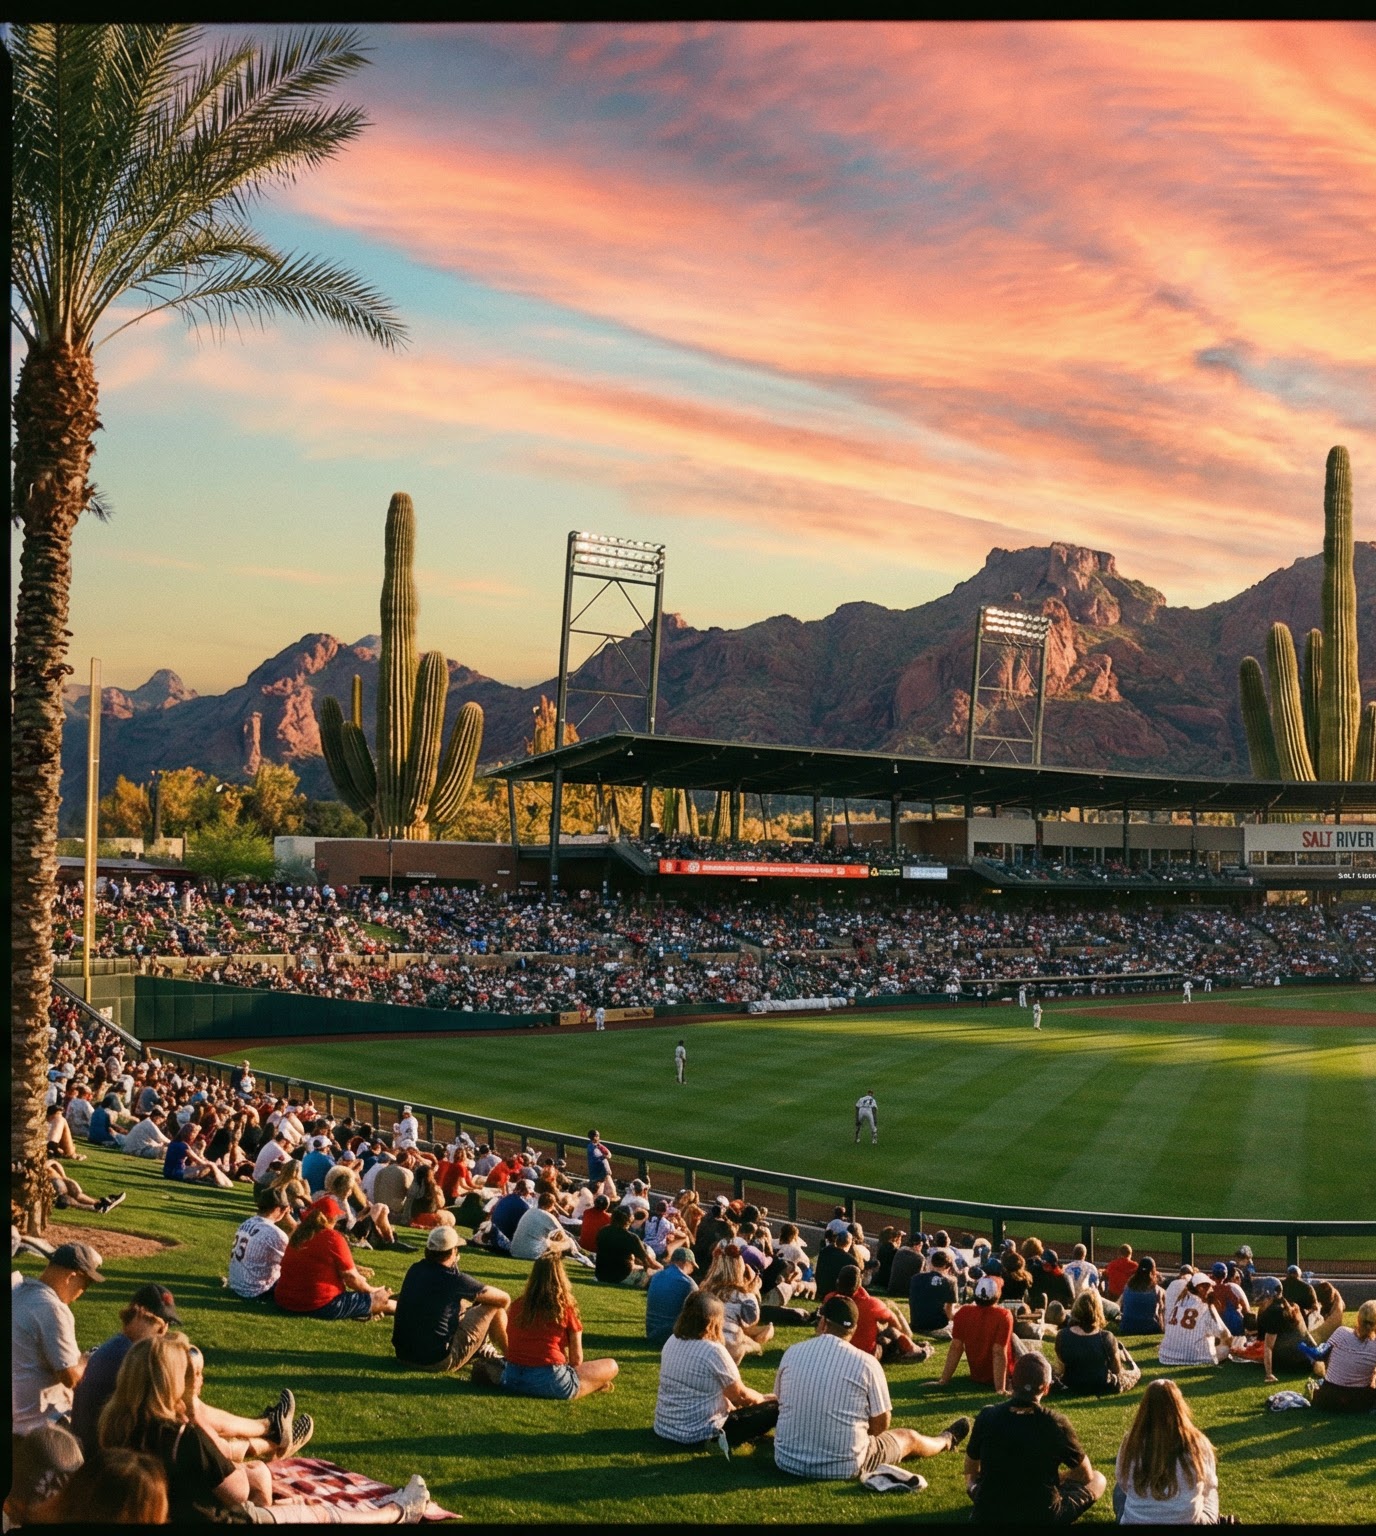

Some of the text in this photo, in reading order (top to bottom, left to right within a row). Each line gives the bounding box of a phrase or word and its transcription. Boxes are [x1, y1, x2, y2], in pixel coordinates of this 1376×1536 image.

[1302, 830, 1333, 848] SALT
[1336, 831, 1374, 848] RIVER
[1168, 1306, 1199, 1330] 18
